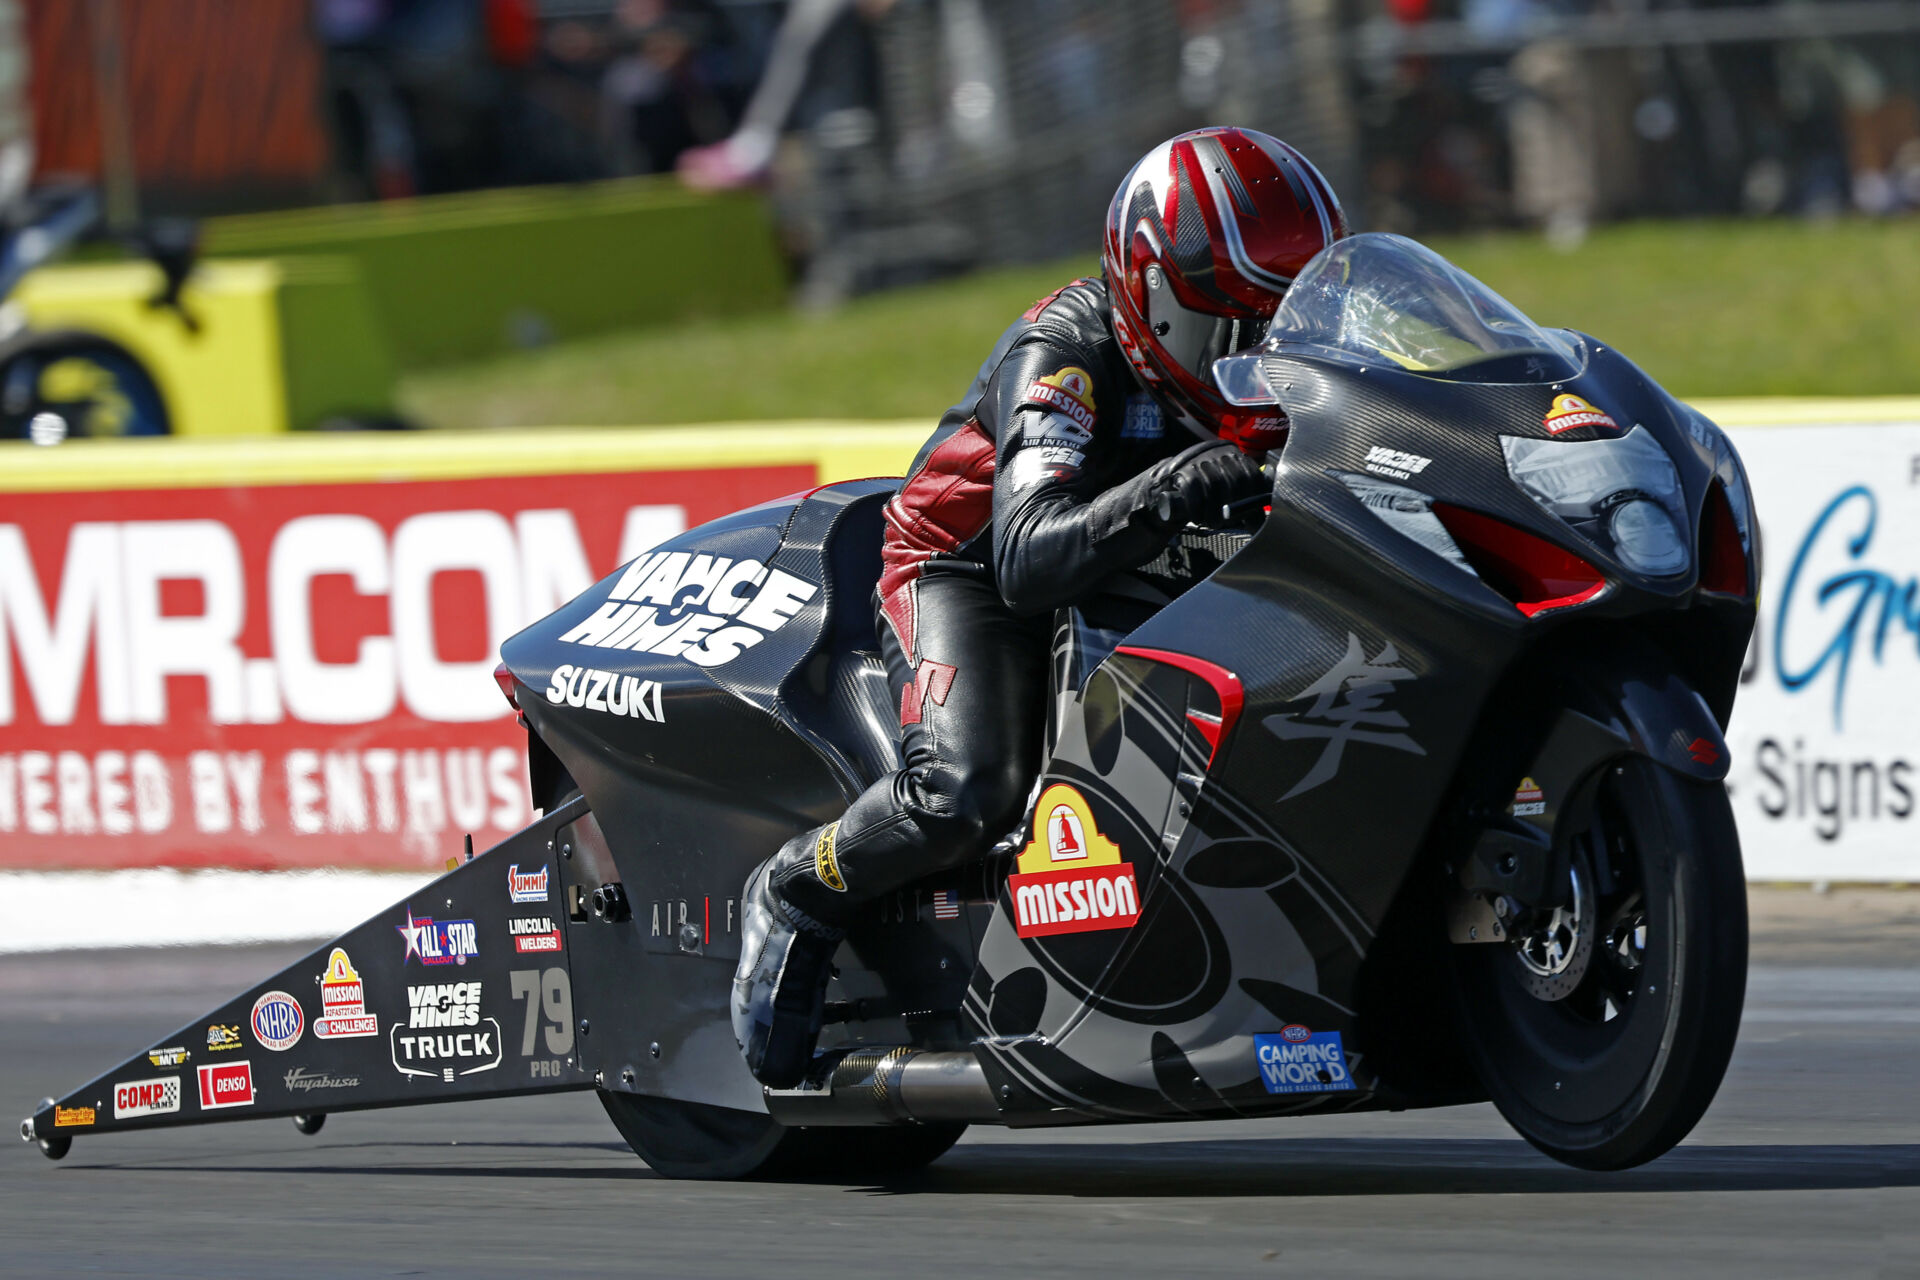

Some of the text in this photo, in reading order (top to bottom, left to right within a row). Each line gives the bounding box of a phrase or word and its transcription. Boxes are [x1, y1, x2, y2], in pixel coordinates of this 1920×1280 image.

[1029, 384, 1095, 431] MISSION
[1548, 412, 1617, 432] MISSION
[1366, 463, 1411, 480] SUZUKI
[607, 551, 819, 632] VANCE
[557, 601, 765, 667] HINES
[546, 664, 666, 723] SUZUKI
[190, 749, 265, 836] BY
[1016, 875, 1138, 926] MISSION
[421, 922, 478, 957] ALL STAR
[509, 918, 552, 935] LINCOLN
[519, 936, 558, 951] WELDERS
[422, 956, 455, 965] CALLOUT
[324, 985, 361, 1003] MISSION
[407, 982, 482, 1009] VANCE
[259, 1003, 298, 1039] NHRA
[409, 1004, 480, 1029] HINES
[510, 967, 575, 1056] 79
[330, 1018, 375, 1034] CHALLENGE
[399, 1032, 493, 1060] TRUCK
[1259, 1043, 1340, 1064] CAMPING
[283, 1067, 360, 1093] Hayabusa
[530, 1060, 561, 1078] PRO
[117, 1083, 163, 1110] COMP
[216, 1076, 246, 1093] DENSO
[149, 1100, 173, 1110] CAMS
